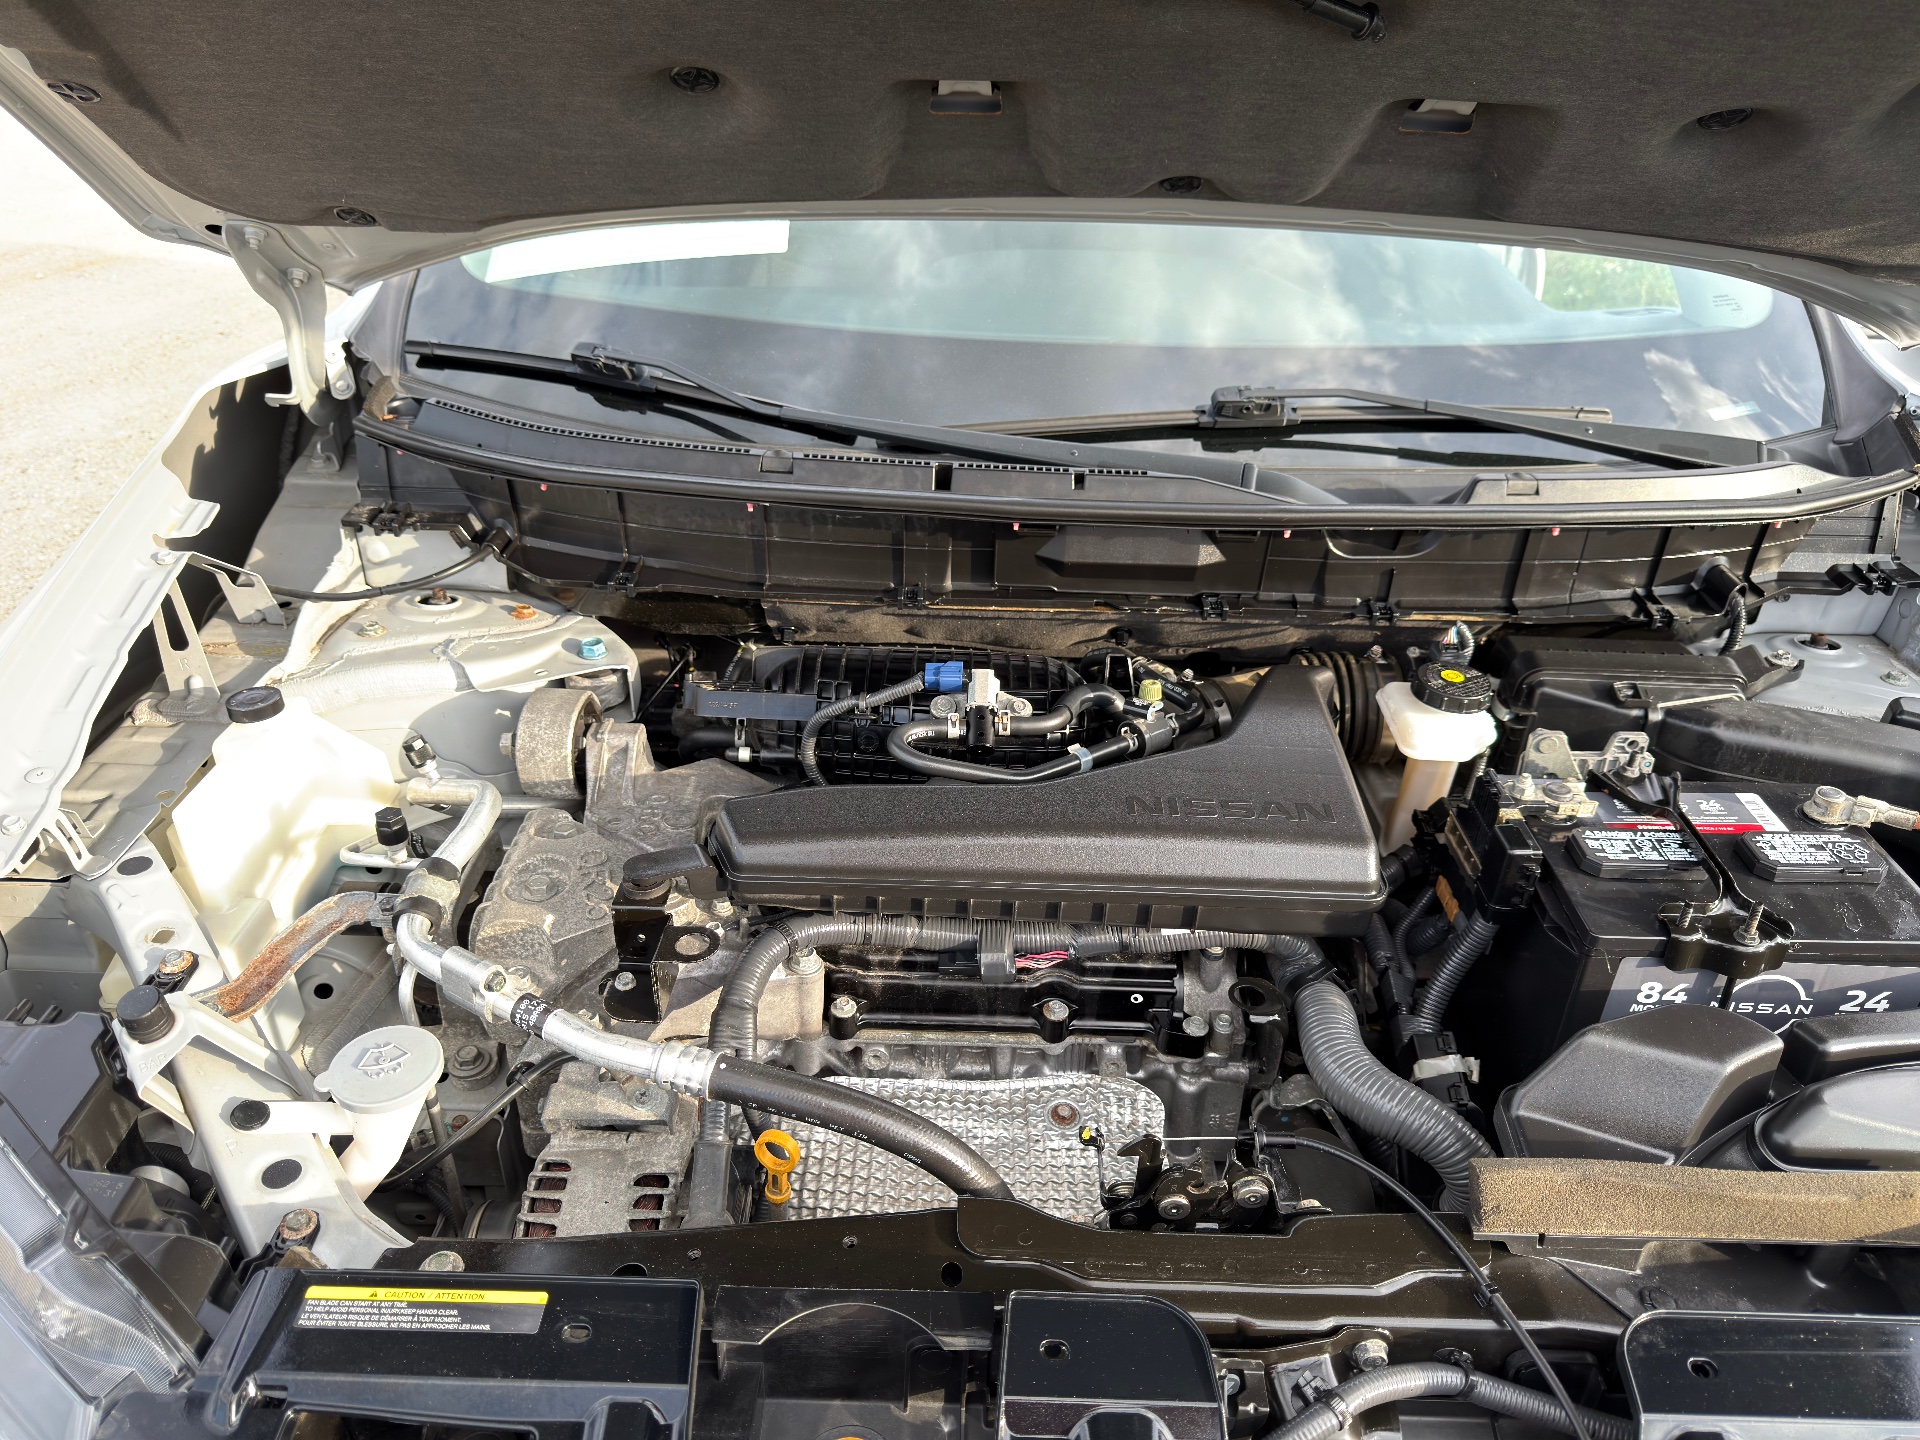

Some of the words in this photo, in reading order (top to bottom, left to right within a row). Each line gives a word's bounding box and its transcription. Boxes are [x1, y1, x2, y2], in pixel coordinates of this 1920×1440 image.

[1125, 796, 1337, 824] NISSAN
[1636, 981, 1690, 1004] 84
[1838, 990, 1893, 1013] 24
[384, 1290, 425, 1299] CAUTION
[435, 1292, 486, 1300] ATTENTION
